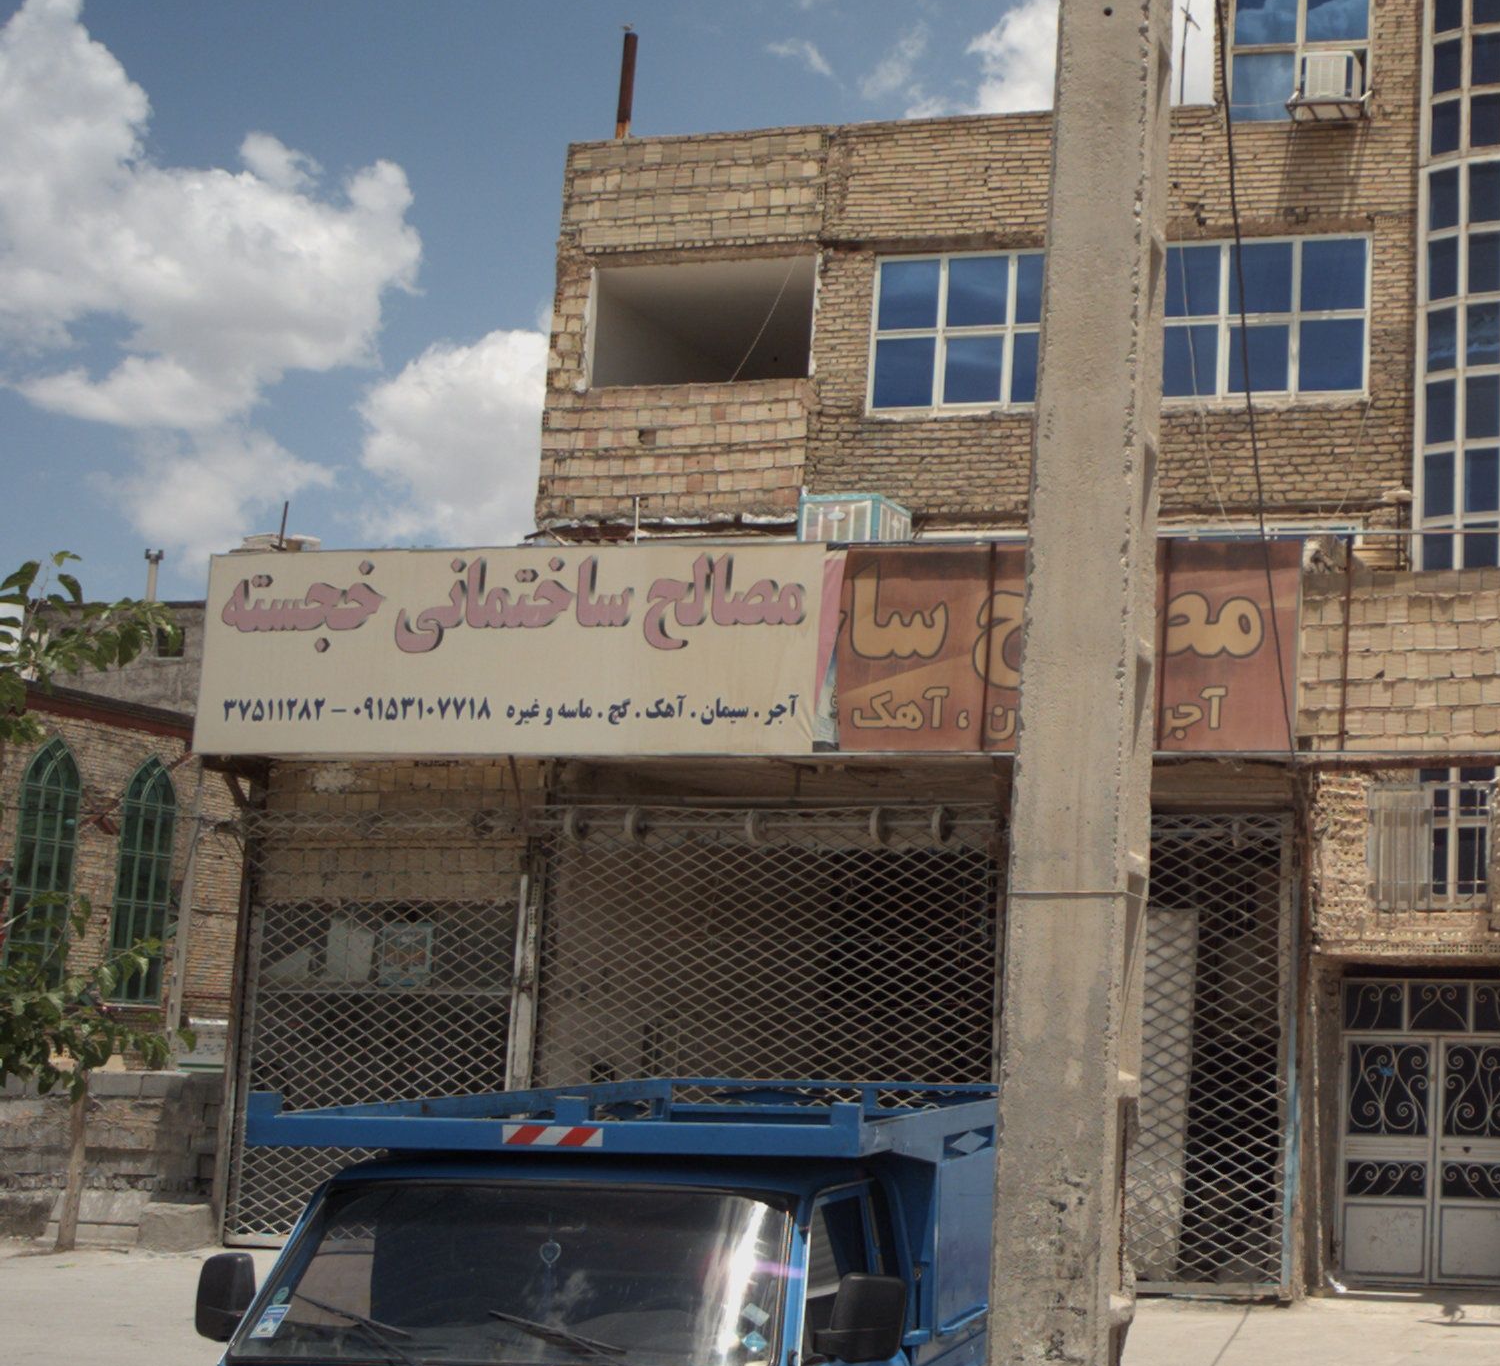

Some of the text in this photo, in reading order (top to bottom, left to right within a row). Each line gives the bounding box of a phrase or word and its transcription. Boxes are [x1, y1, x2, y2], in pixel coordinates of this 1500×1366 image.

[221, 553, 807, 653] مصالح ساختمانی خجسته
[505, 697, 540, 726] غیره
[543, 705, 553, 726] و
[557, 697, 593, 720] ماسه
[607, 697, 631, 726] گچ
[645, 694, 687, 719] آهک
[700, 697, 749, 726] سیمان
[763, 694, 799, 726] آجر
[852, 686, 949, 731] آهک
